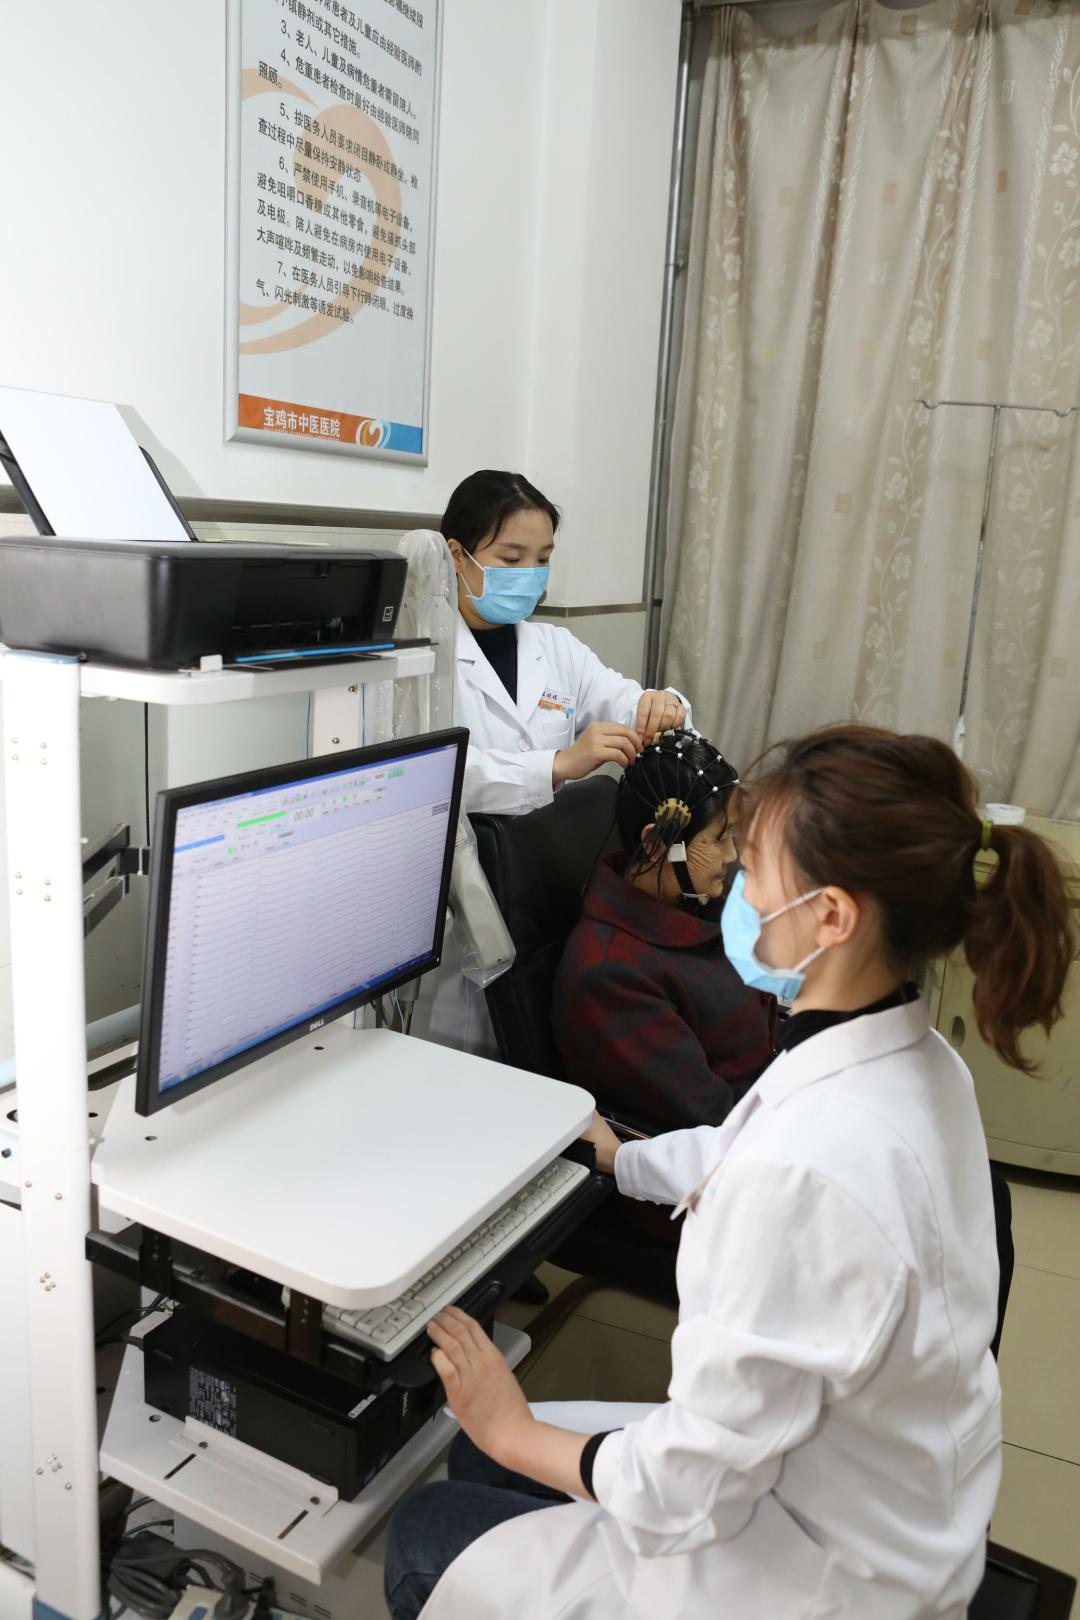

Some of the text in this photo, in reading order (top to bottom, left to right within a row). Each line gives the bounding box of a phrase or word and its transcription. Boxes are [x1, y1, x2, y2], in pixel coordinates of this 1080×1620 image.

[259, 61, 282, 88] 照顾。
[258, 118, 361, 183] 查过程中尽量保持安静状态
[263, 407, 340, 437] 宝鸡市中医医院
